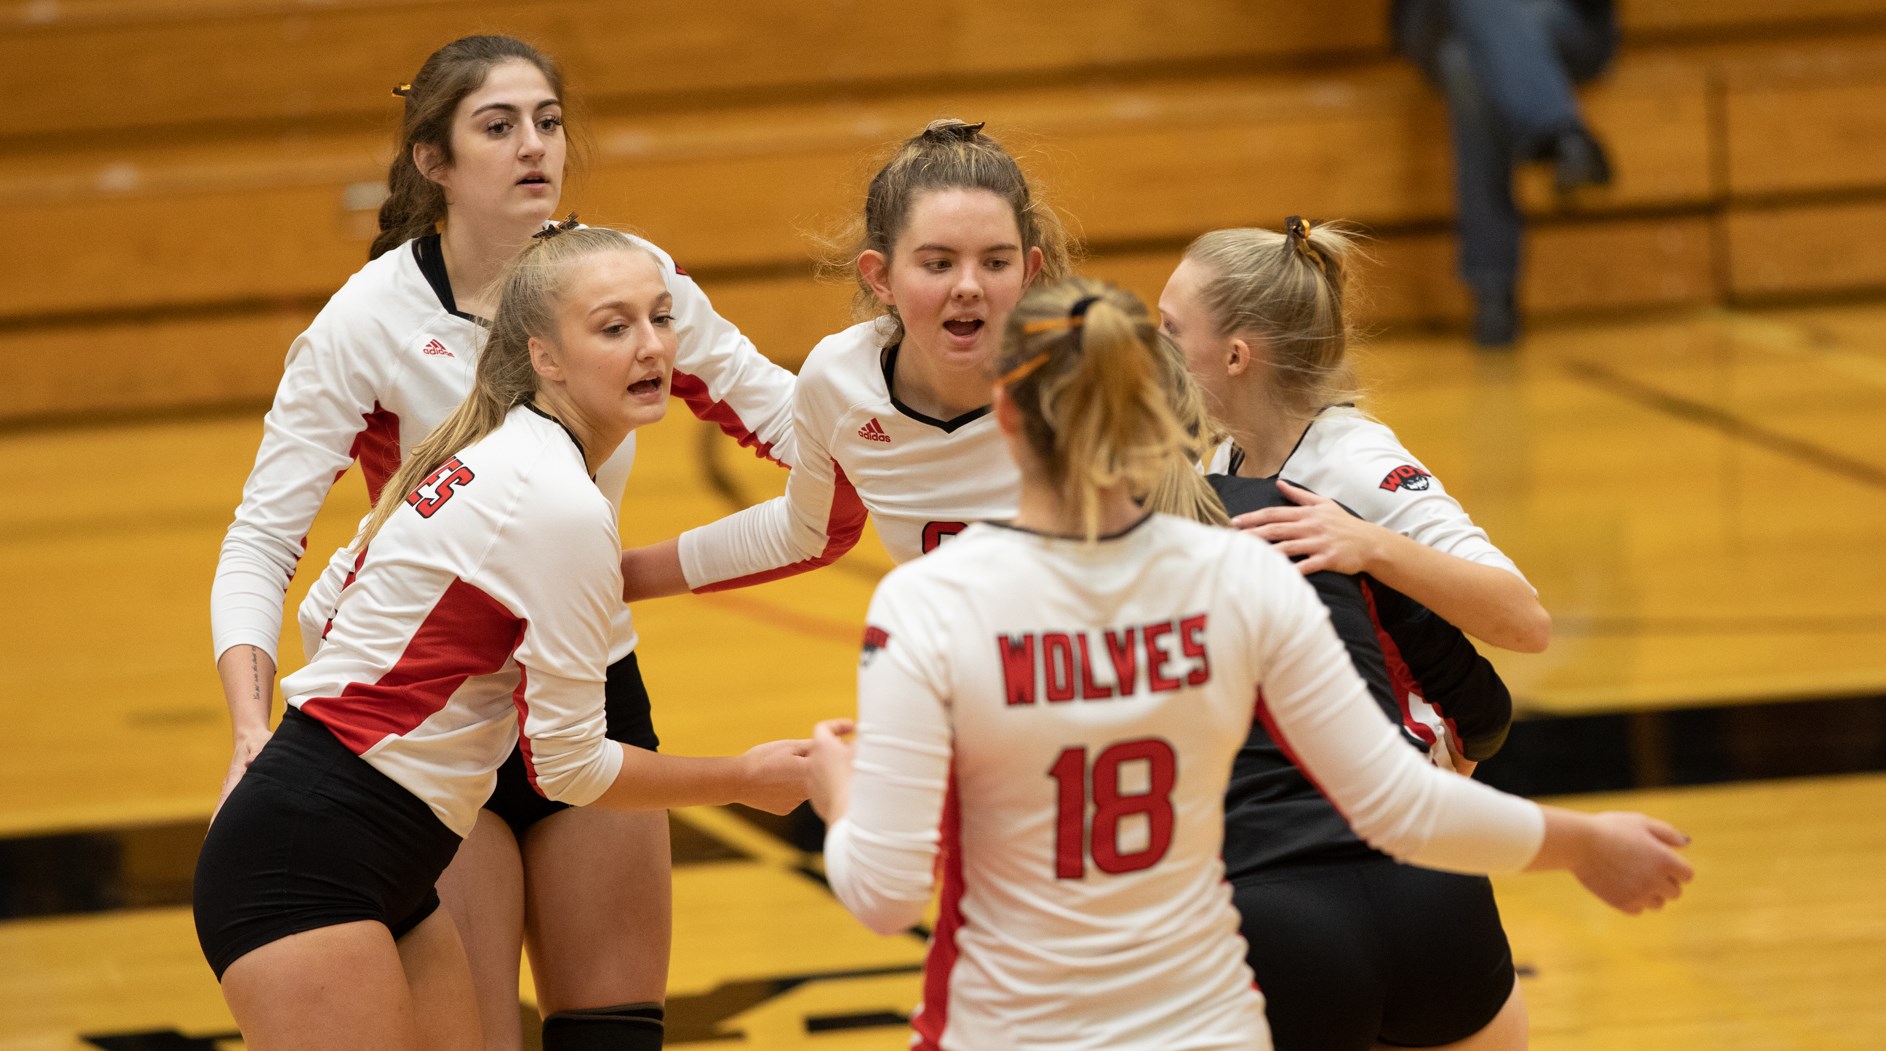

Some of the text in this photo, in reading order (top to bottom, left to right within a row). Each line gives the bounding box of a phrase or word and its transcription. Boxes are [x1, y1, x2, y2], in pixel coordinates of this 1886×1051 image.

[858, 430, 891, 443] adidas
[405, 455, 475, 519] ES
[997, 612, 1211, 707] WOLVES
[1047, 736, 1178, 880] 18
